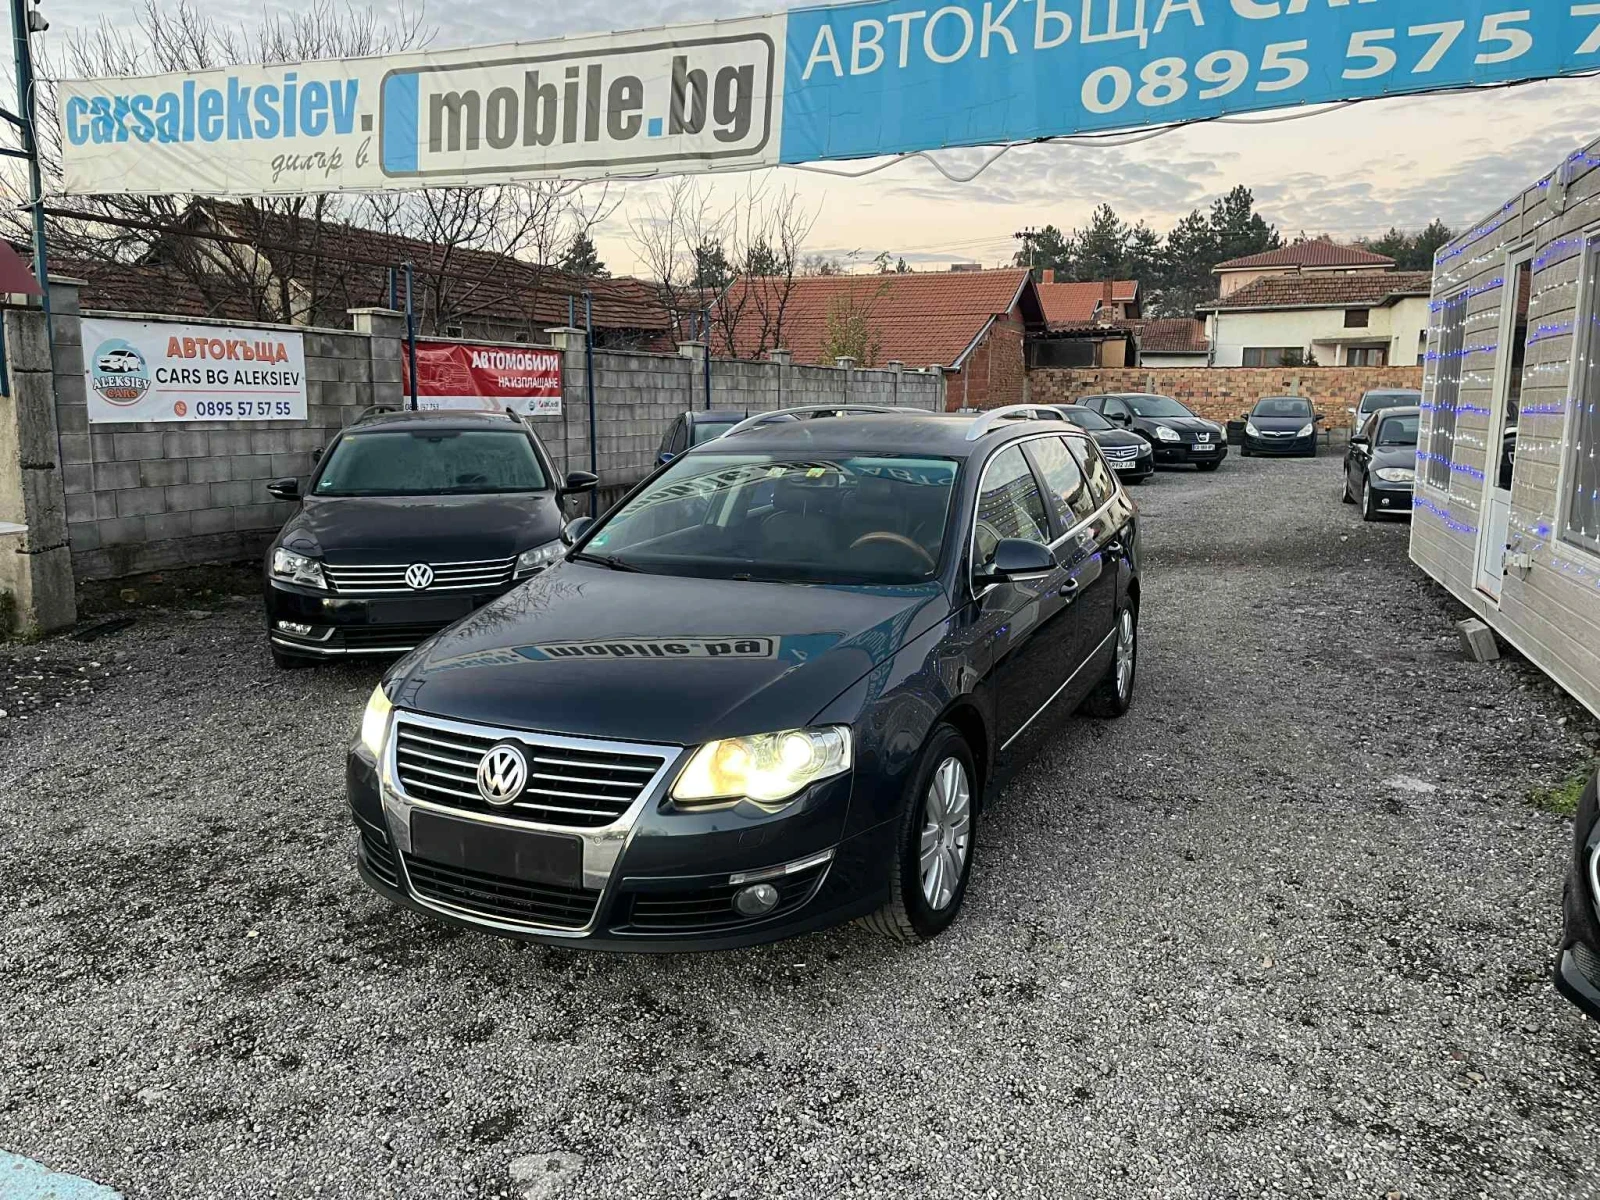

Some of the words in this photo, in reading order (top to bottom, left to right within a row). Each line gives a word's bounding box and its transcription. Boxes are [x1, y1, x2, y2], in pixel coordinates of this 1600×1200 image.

[1081, 39, 1309, 114] 0895
[1342, 10, 1532, 80] 575
[429, 55, 755, 154] mobile.bg
[167, 336, 289, 365] АВТОКЪЩА
[472, 350, 559, 371] АВТОМОБИЛИ
[93, 375, 151, 391] ALEKSIEV
[156, 367, 201, 385] CARS
[207, 369, 229, 385] BG
[234, 371, 299, 386] ALEKSIEV
[498, 377, 510, 388] НА
[511, 377, 558, 390] ИЗПЛАЩАНЕ
[106, 388, 138, 399] CARS
[196, 402, 233, 416] 0895
[238, 402, 253, 416] 57
[257, 402, 271, 416] 57
[276, 402, 291, 416] 55
[477, 744, 528, 805] VW
